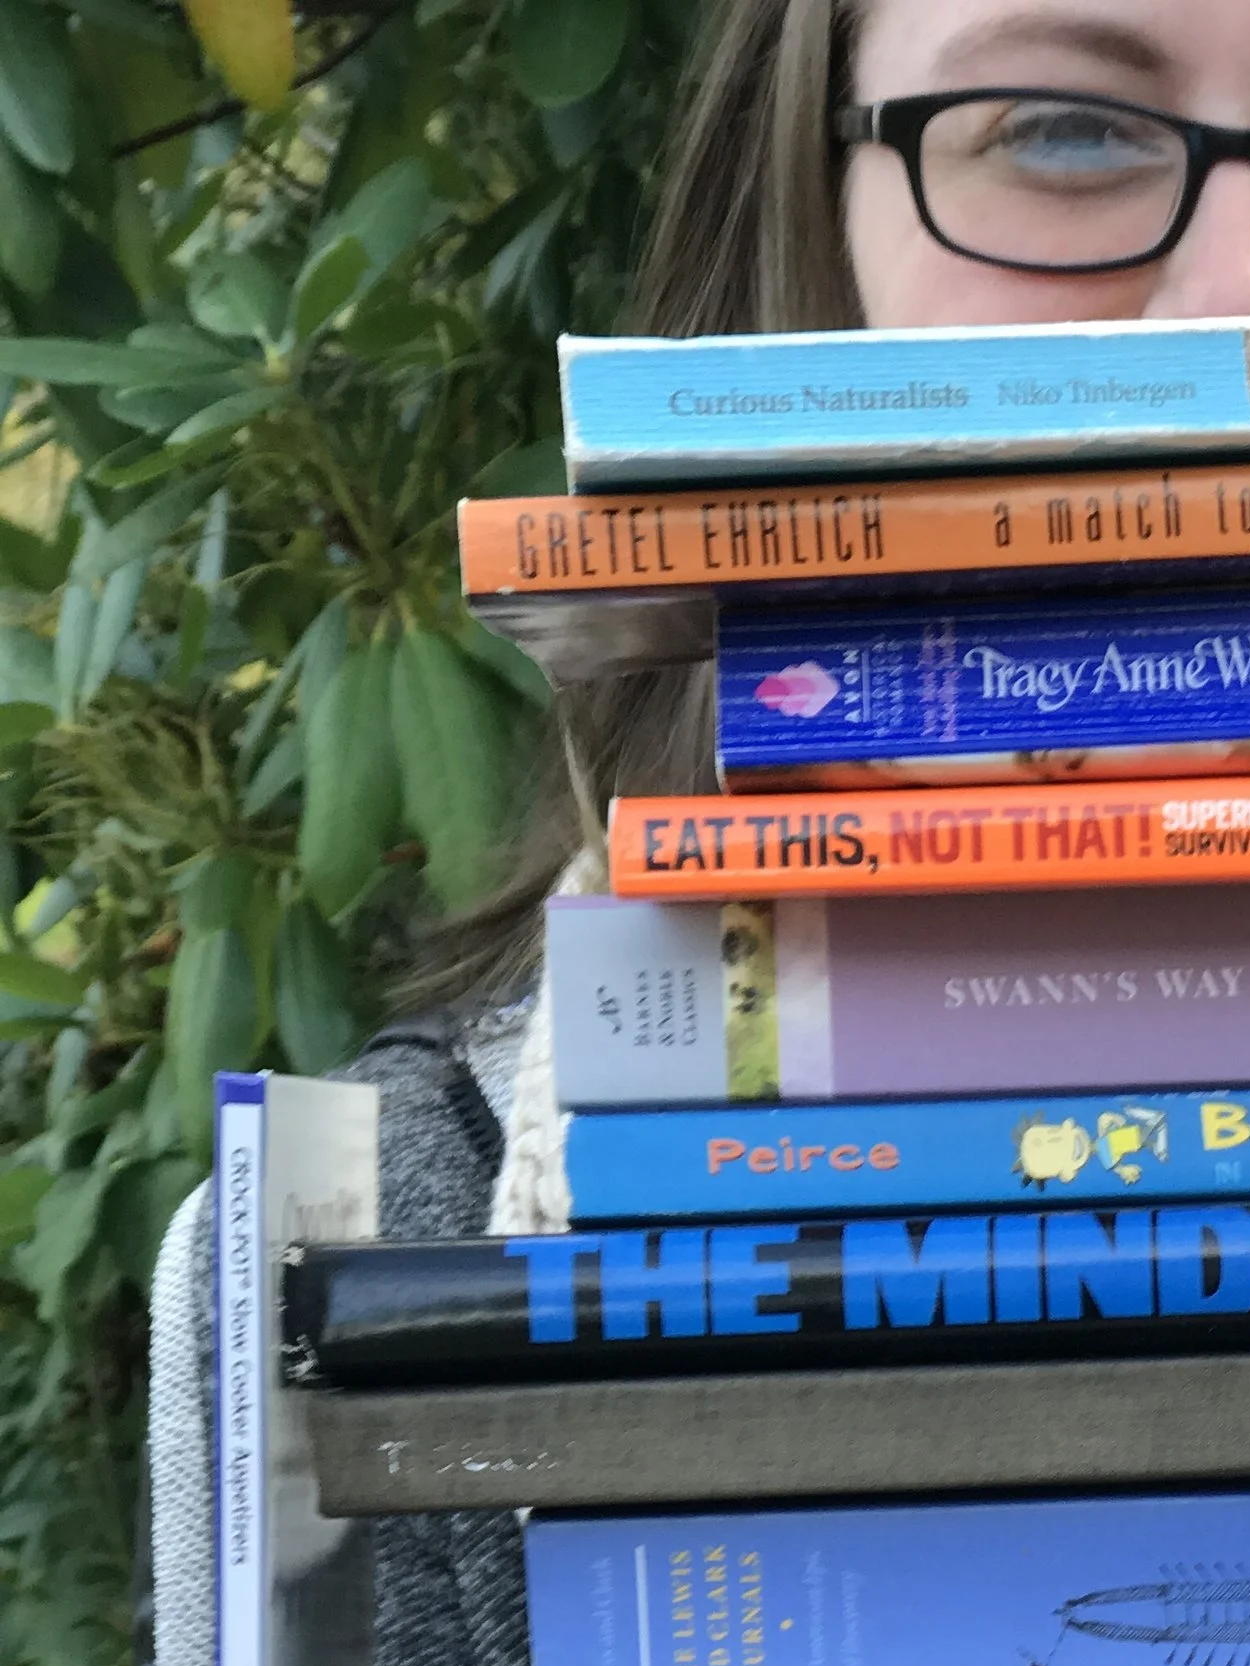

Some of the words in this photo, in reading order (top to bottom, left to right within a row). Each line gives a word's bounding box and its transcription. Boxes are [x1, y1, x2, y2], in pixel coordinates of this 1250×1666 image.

[668, 388, 793, 417] Curious
[800, 380, 970, 414] Naturalists
[997, 379, 1061, 406] Niko
[1068, 377, 1197, 407] Tinbergen
[517, 504, 676, 581] GRETEL
[702, 493, 885, 569] EHRLICH
[993, 501, 1012, 547] a
[1047, 474, 1182, 546] match
[963, 645, 1091, 713] Tracy
[1093, 641, 1209, 694] Anne
[644, 816, 738, 871] EAT
[742, 813, 879, 873] THIS,
[889, 808, 993, 864] NOT
[1003, 803, 1157, 861] THAT!
[944, 969, 1138, 1009] SWANN'S
[1156, 966, 1245, 999] WAY
[707, 1136, 901, 1176] Peirce
[1214, 1158, 1241, 1185] IN
[504, 1225, 800, 1343] THE
[230, 1360, 252, 1439] Cooker
[668, 1549, 696, 1640] LEWIS
[703, 1544, 731, 1642] CLARK
